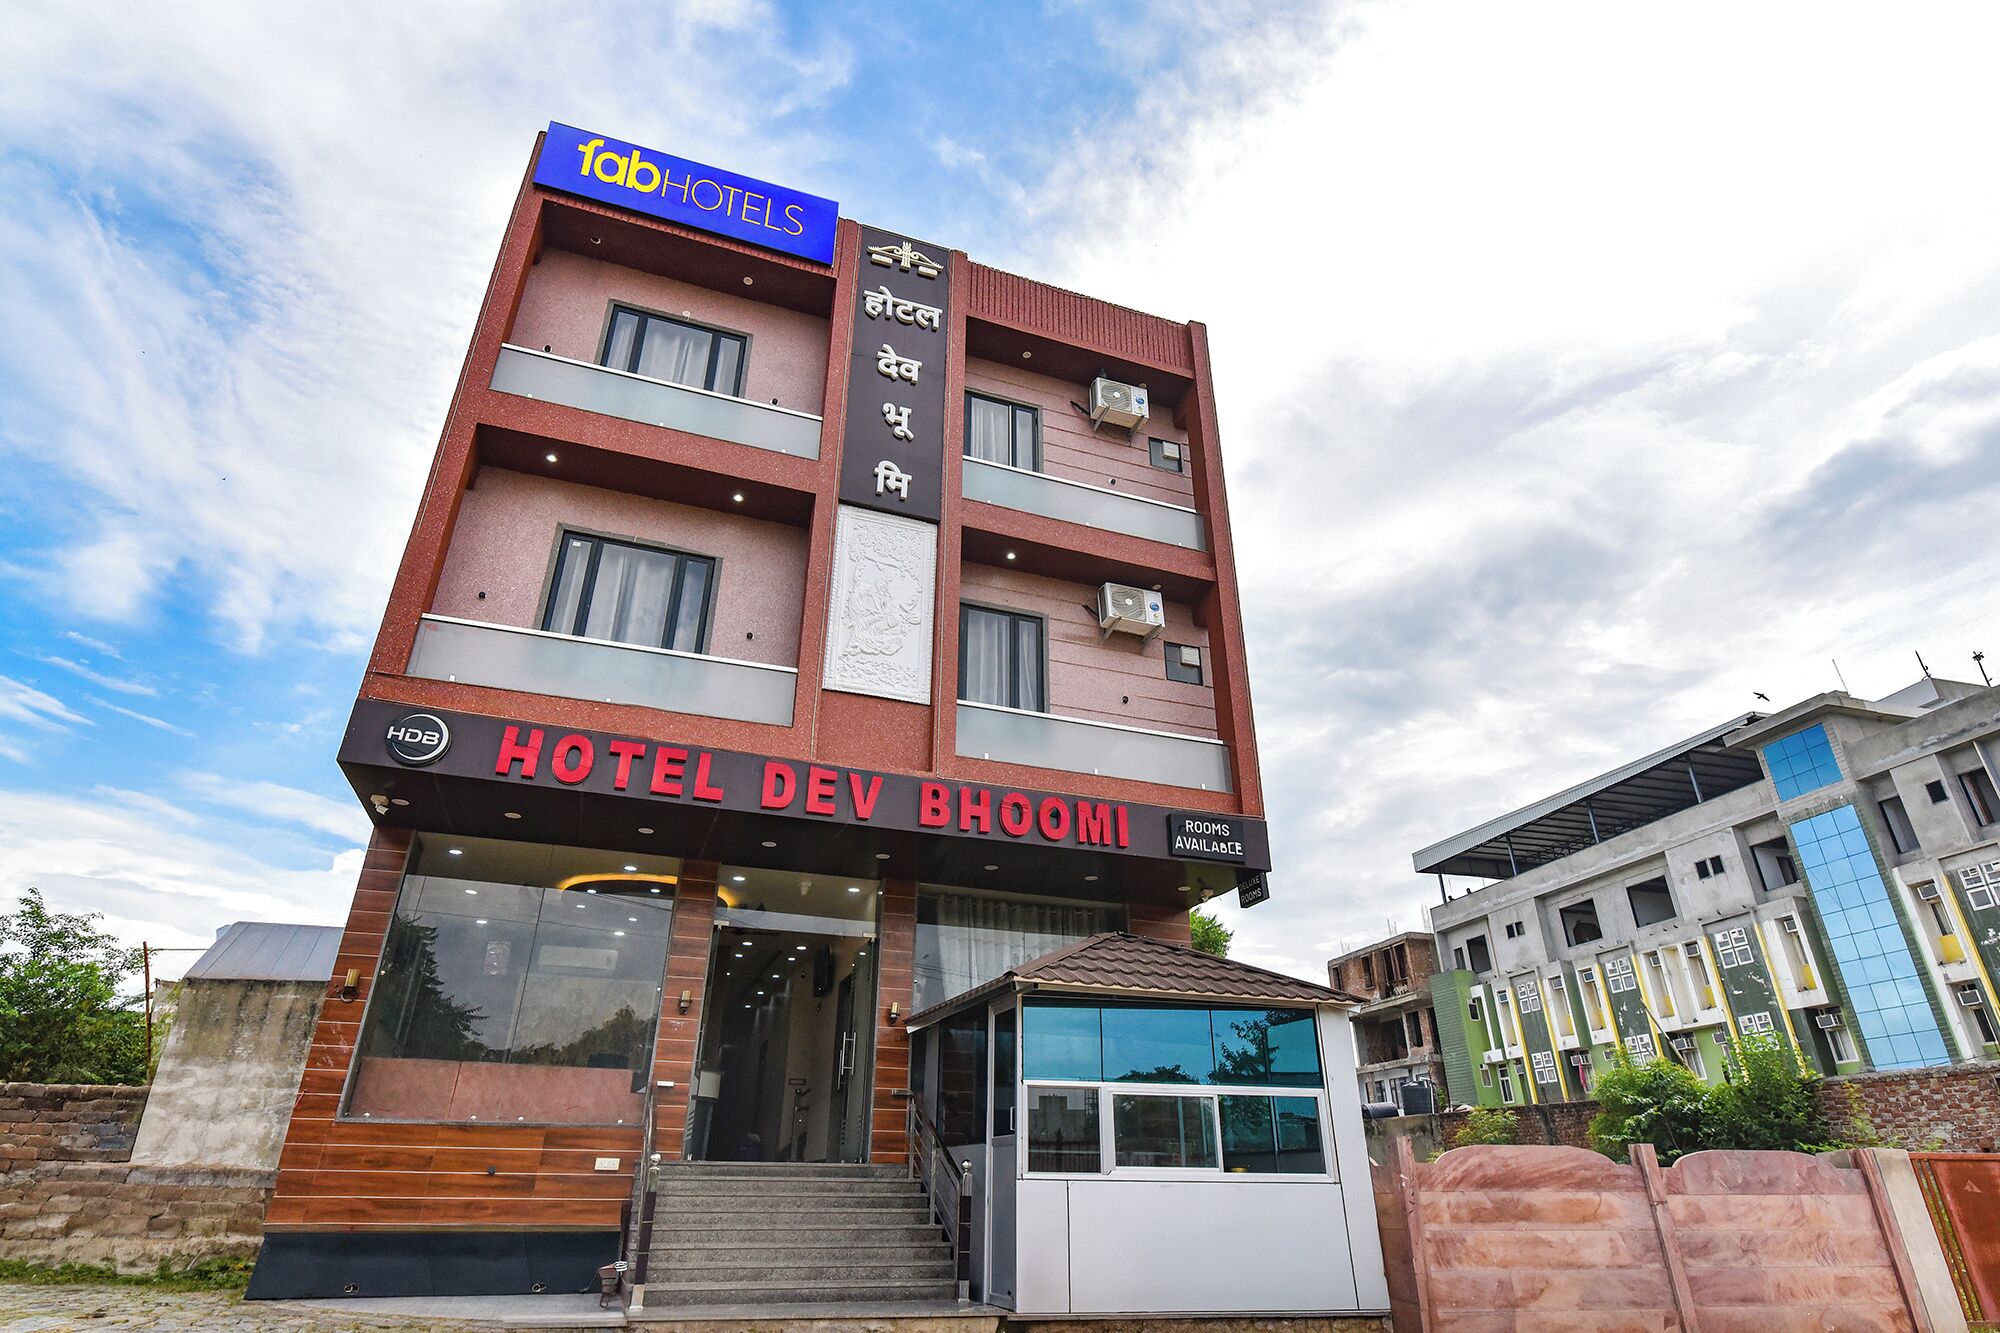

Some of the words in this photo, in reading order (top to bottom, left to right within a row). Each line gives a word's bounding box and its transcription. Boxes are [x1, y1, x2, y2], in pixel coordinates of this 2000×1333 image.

[577, 138, 804, 236] fabHOTELS
[863, 285, 943, 330] होटल
[877, 343, 922, 384] देव
[386, 726, 440, 745] HDB
[495, 725, 724, 803] HOTEL
[760, 761, 883, 821] DEV
[918, 782, 1129, 849] BHOOMI
[1185, 820, 1230, 836] ROOMS
[1241, 887, 1262, 905] ROOMS
